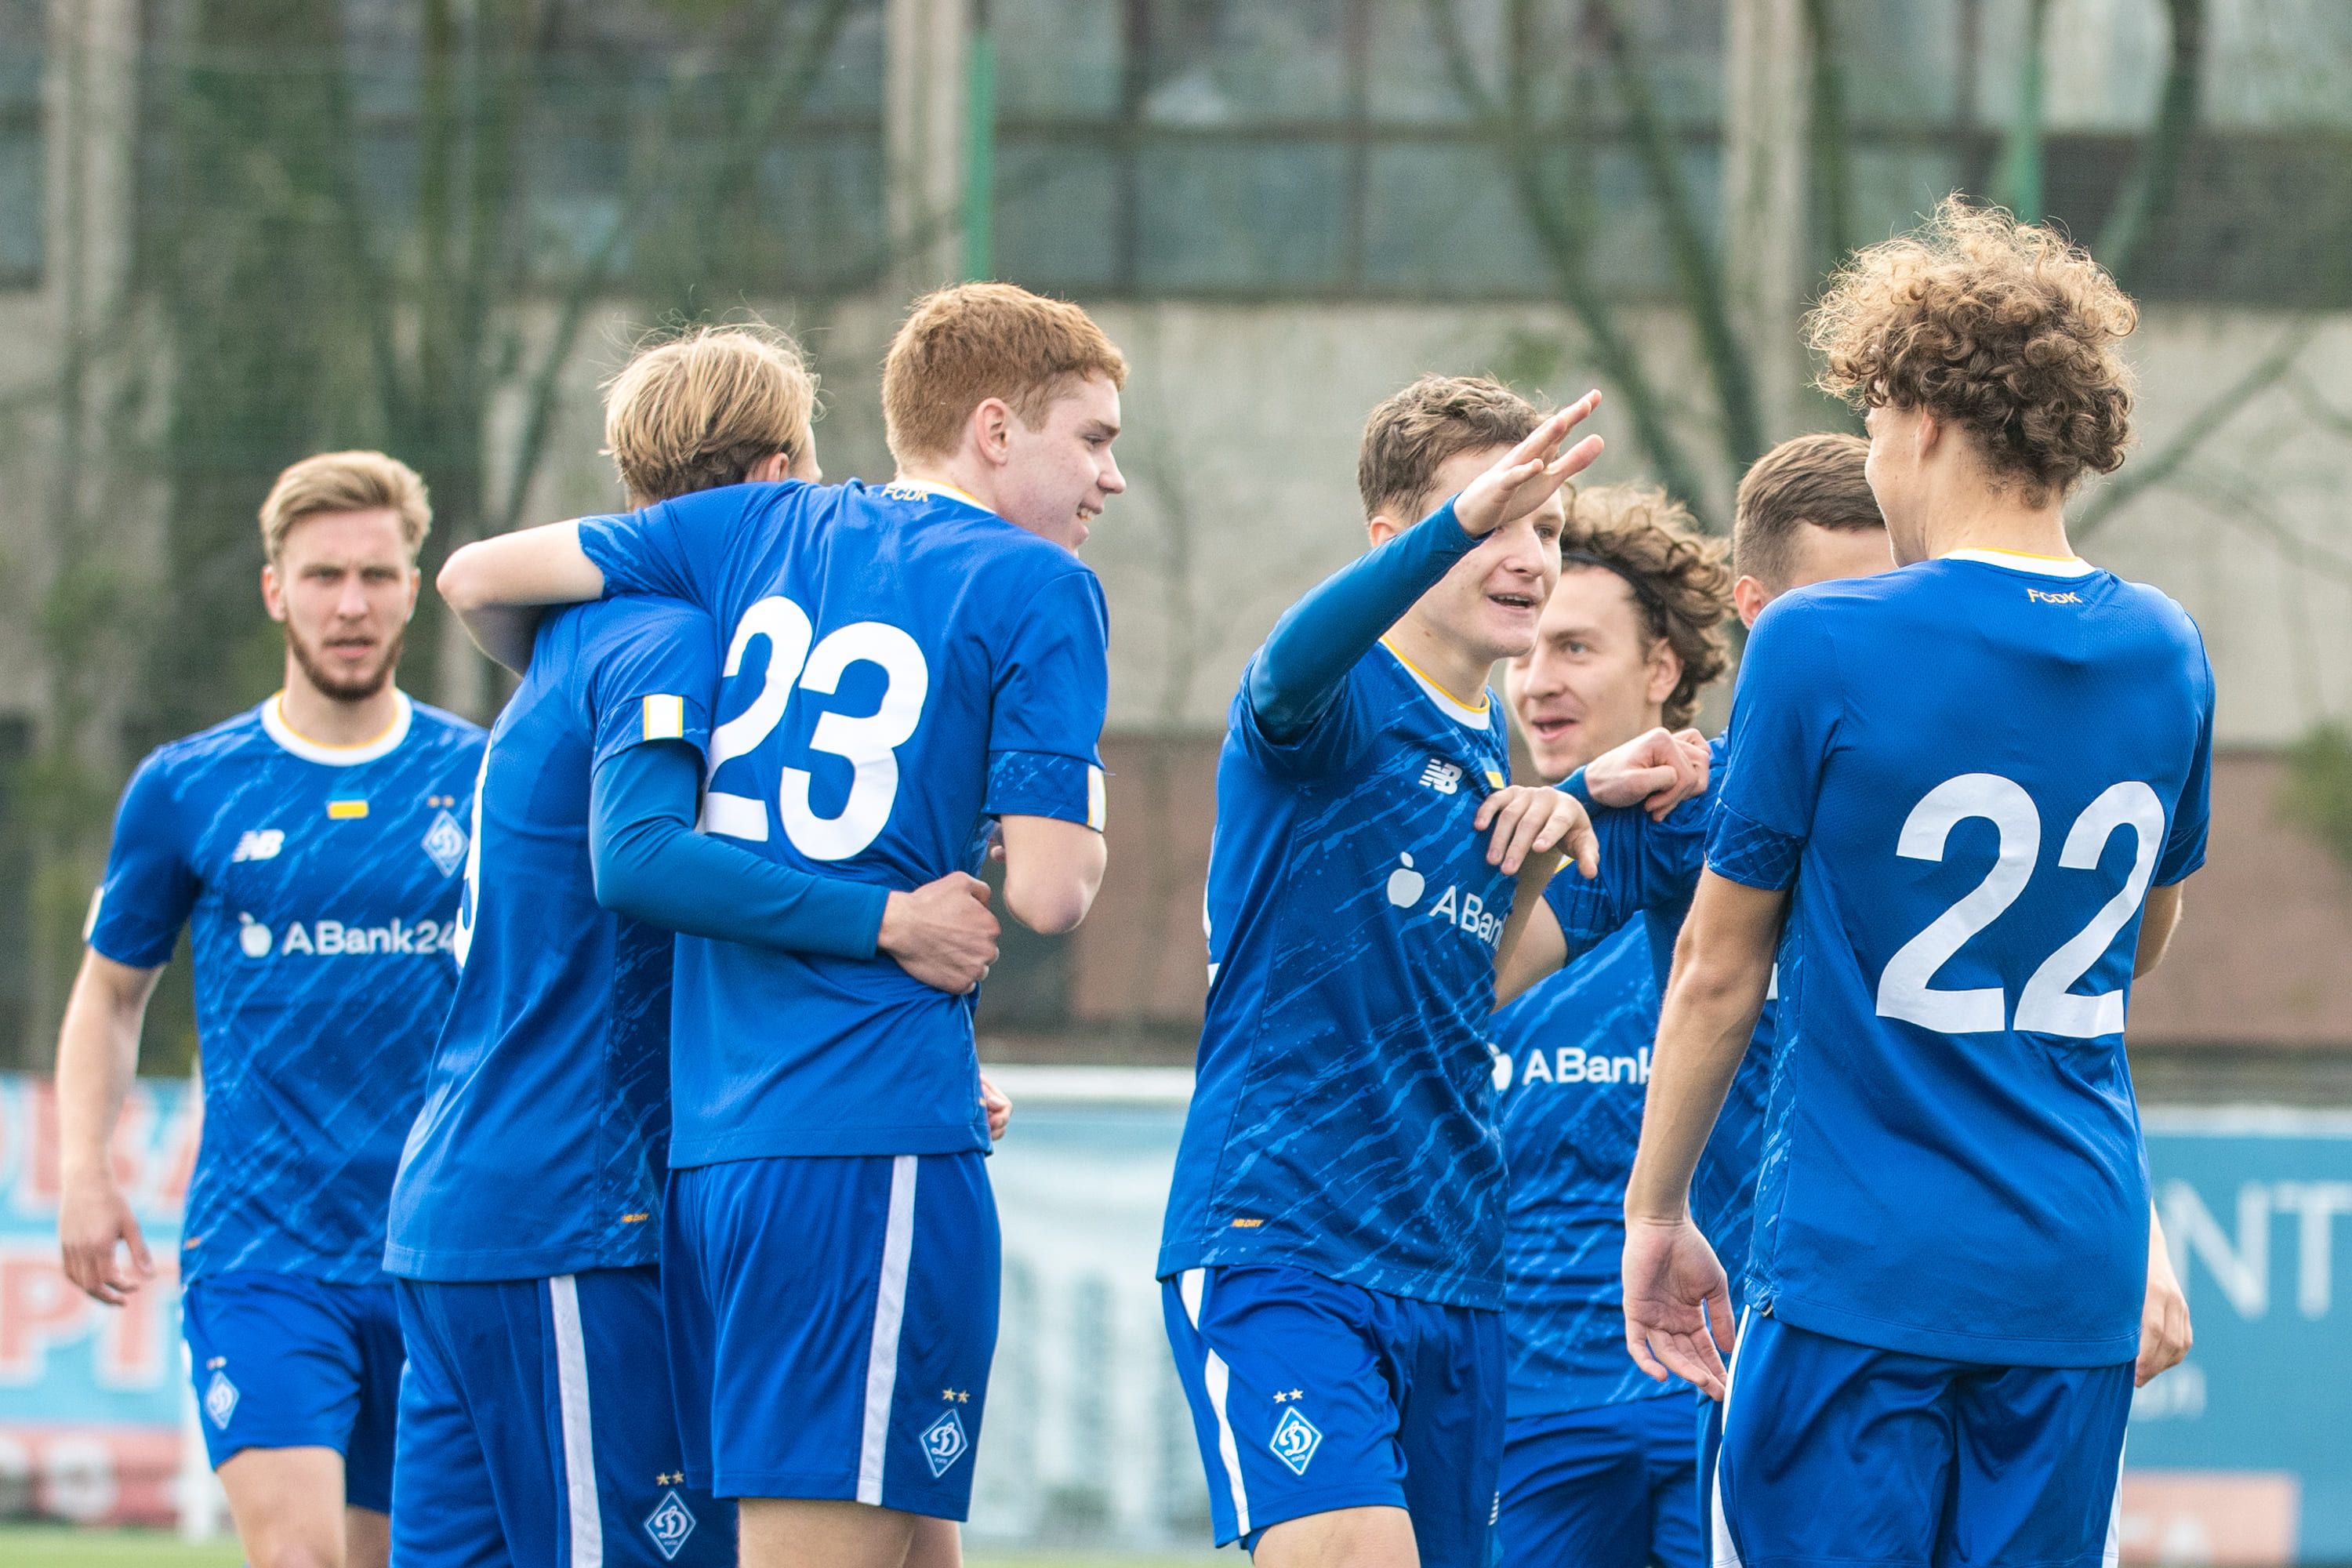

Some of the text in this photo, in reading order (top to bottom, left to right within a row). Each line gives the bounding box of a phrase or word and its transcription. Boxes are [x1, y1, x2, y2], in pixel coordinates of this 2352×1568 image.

[880, 485, 928, 503] FCDK
[2027, 588, 2082, 604] FCDK
[699, 596, 928, 861] 23
[1875, 773, 2165, 1038] 22
